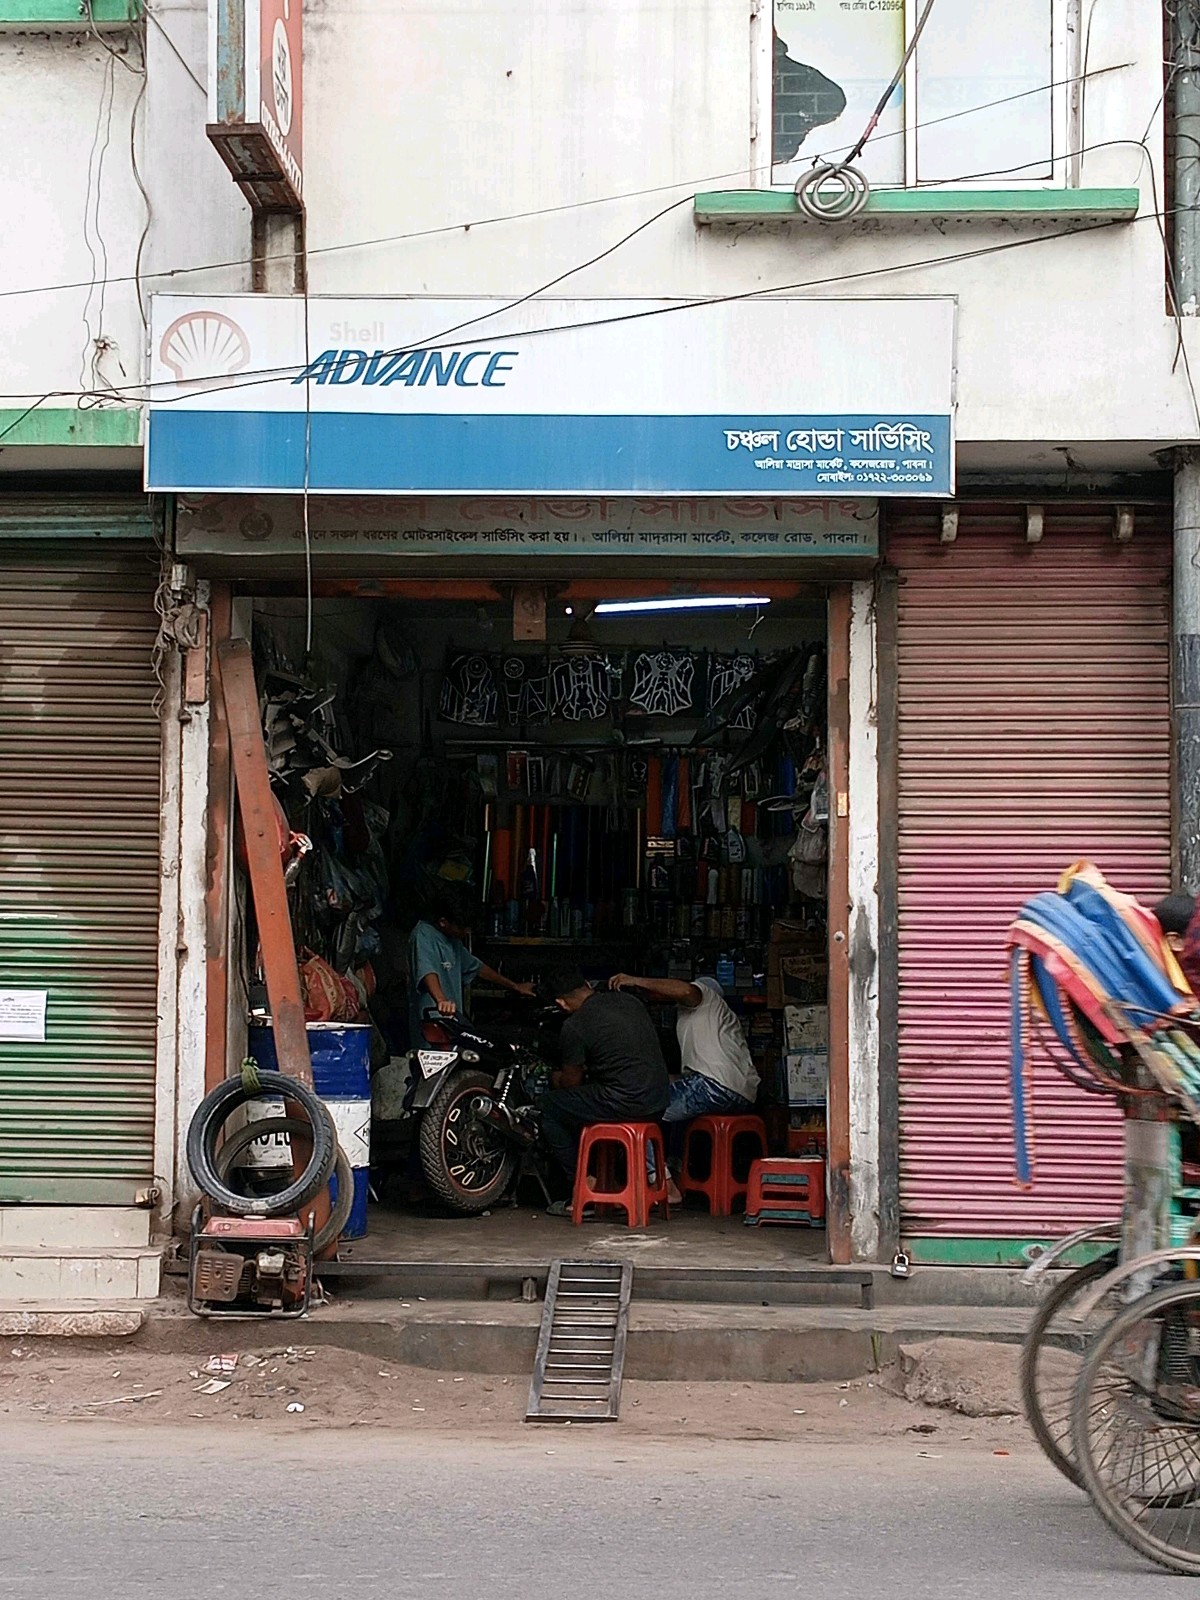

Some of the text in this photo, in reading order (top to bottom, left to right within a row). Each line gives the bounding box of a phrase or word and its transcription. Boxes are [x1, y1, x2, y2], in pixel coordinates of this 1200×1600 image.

[329, 321, 385, 343] Shell
[291, 349, 519, 387] ADVANCE
[723, 421, 934, 453] চঞ্চল হোন্ডা সার্ভিসিং
[402, 527, 478, 542] মোটরসাইকেল
[481, 527, 525, 543] সার্ভিসিং
[528, 530, 550, 542] করা
[591, 529, 634, 543] আলিয়া
[739, 531, 779, 544] কলেজ
